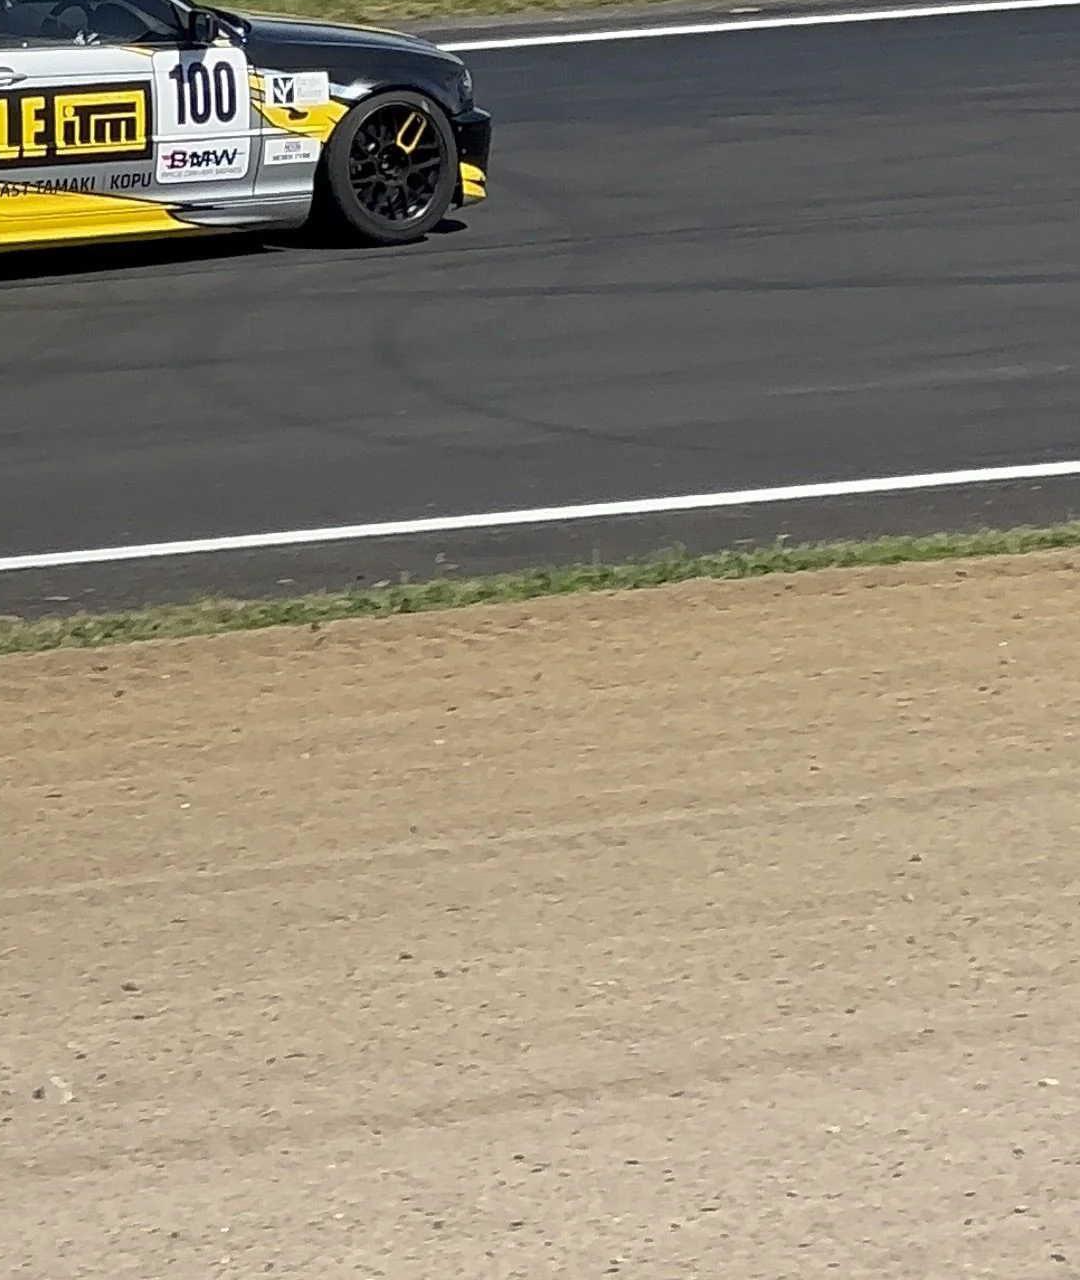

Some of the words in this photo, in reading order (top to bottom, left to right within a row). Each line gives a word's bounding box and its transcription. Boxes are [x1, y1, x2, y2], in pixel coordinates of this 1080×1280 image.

[168, 61, 237, 126] 100
[35, 176, 96, 196] TAMAKI
[110, 172, 152, 190] KOPU
